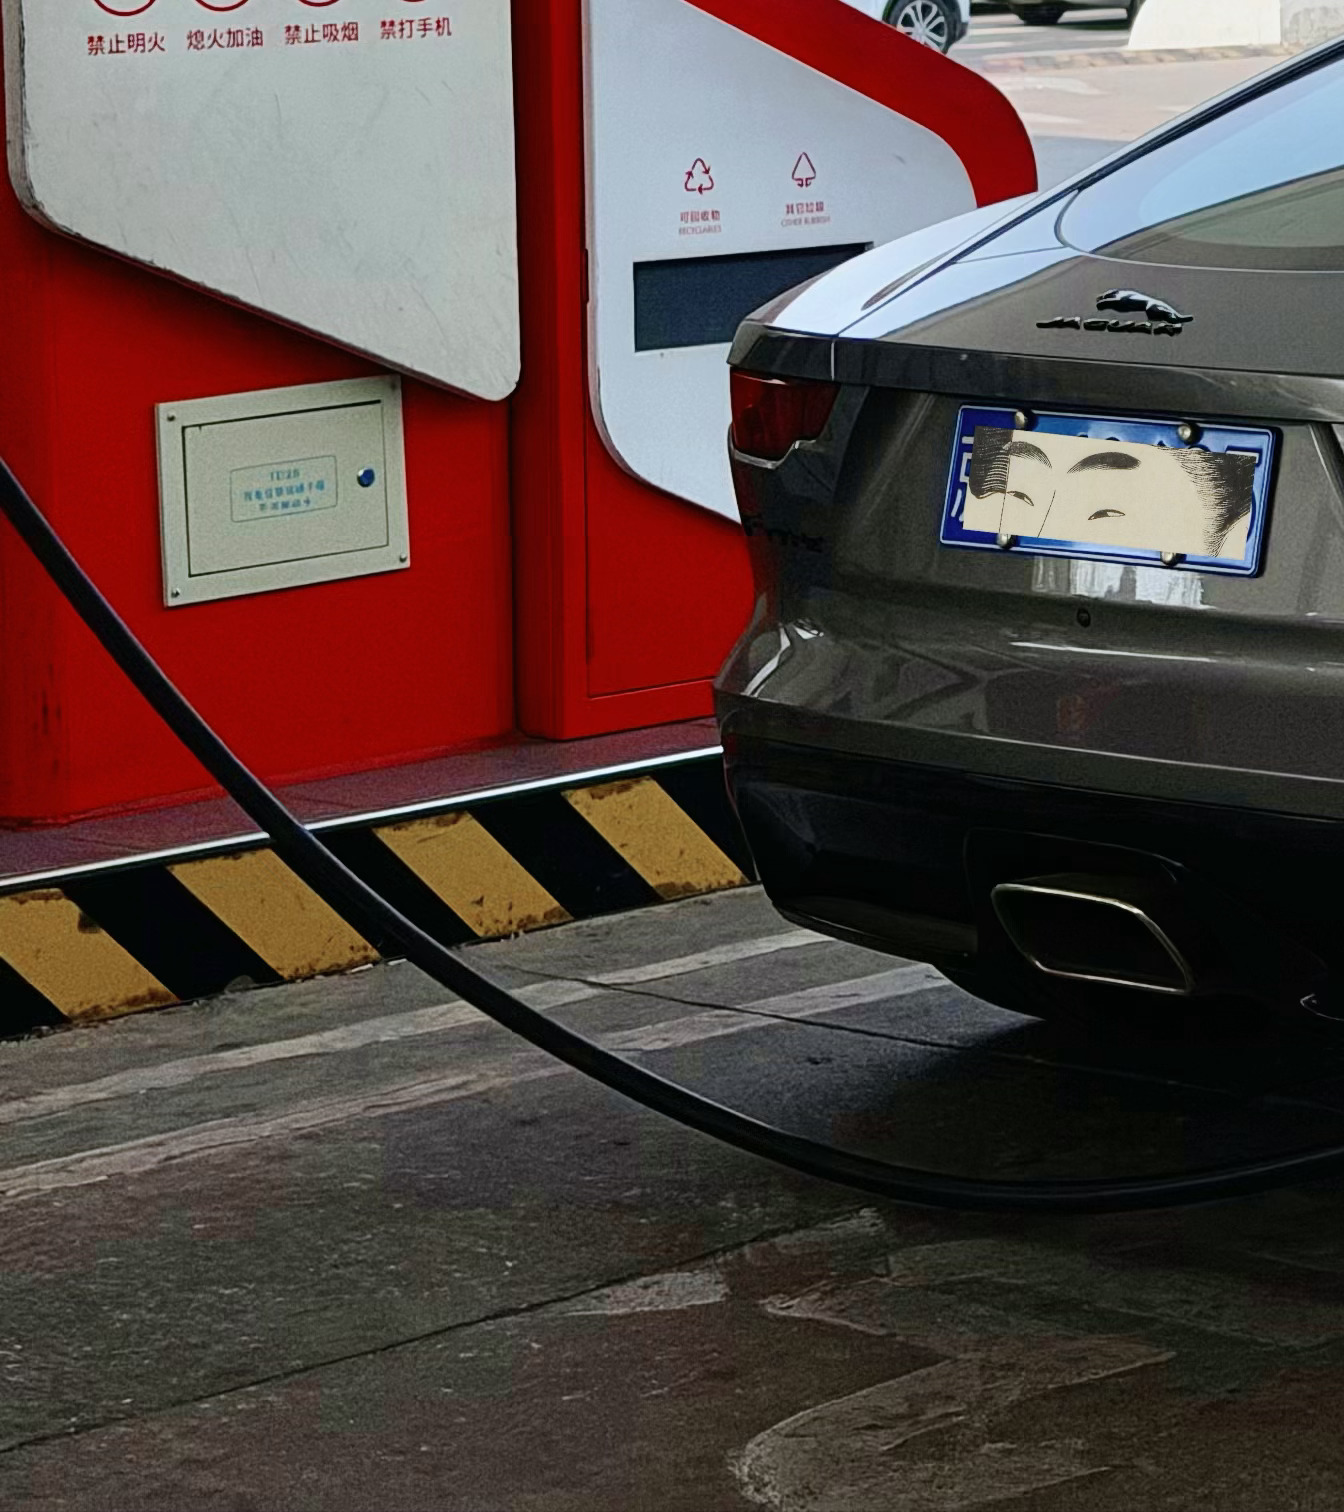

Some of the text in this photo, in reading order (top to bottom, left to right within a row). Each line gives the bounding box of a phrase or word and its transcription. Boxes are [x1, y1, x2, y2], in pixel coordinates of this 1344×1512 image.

[87, 16, 453, 56] 禁止明火 熄火加油 禁止吸烟 禁打手机
